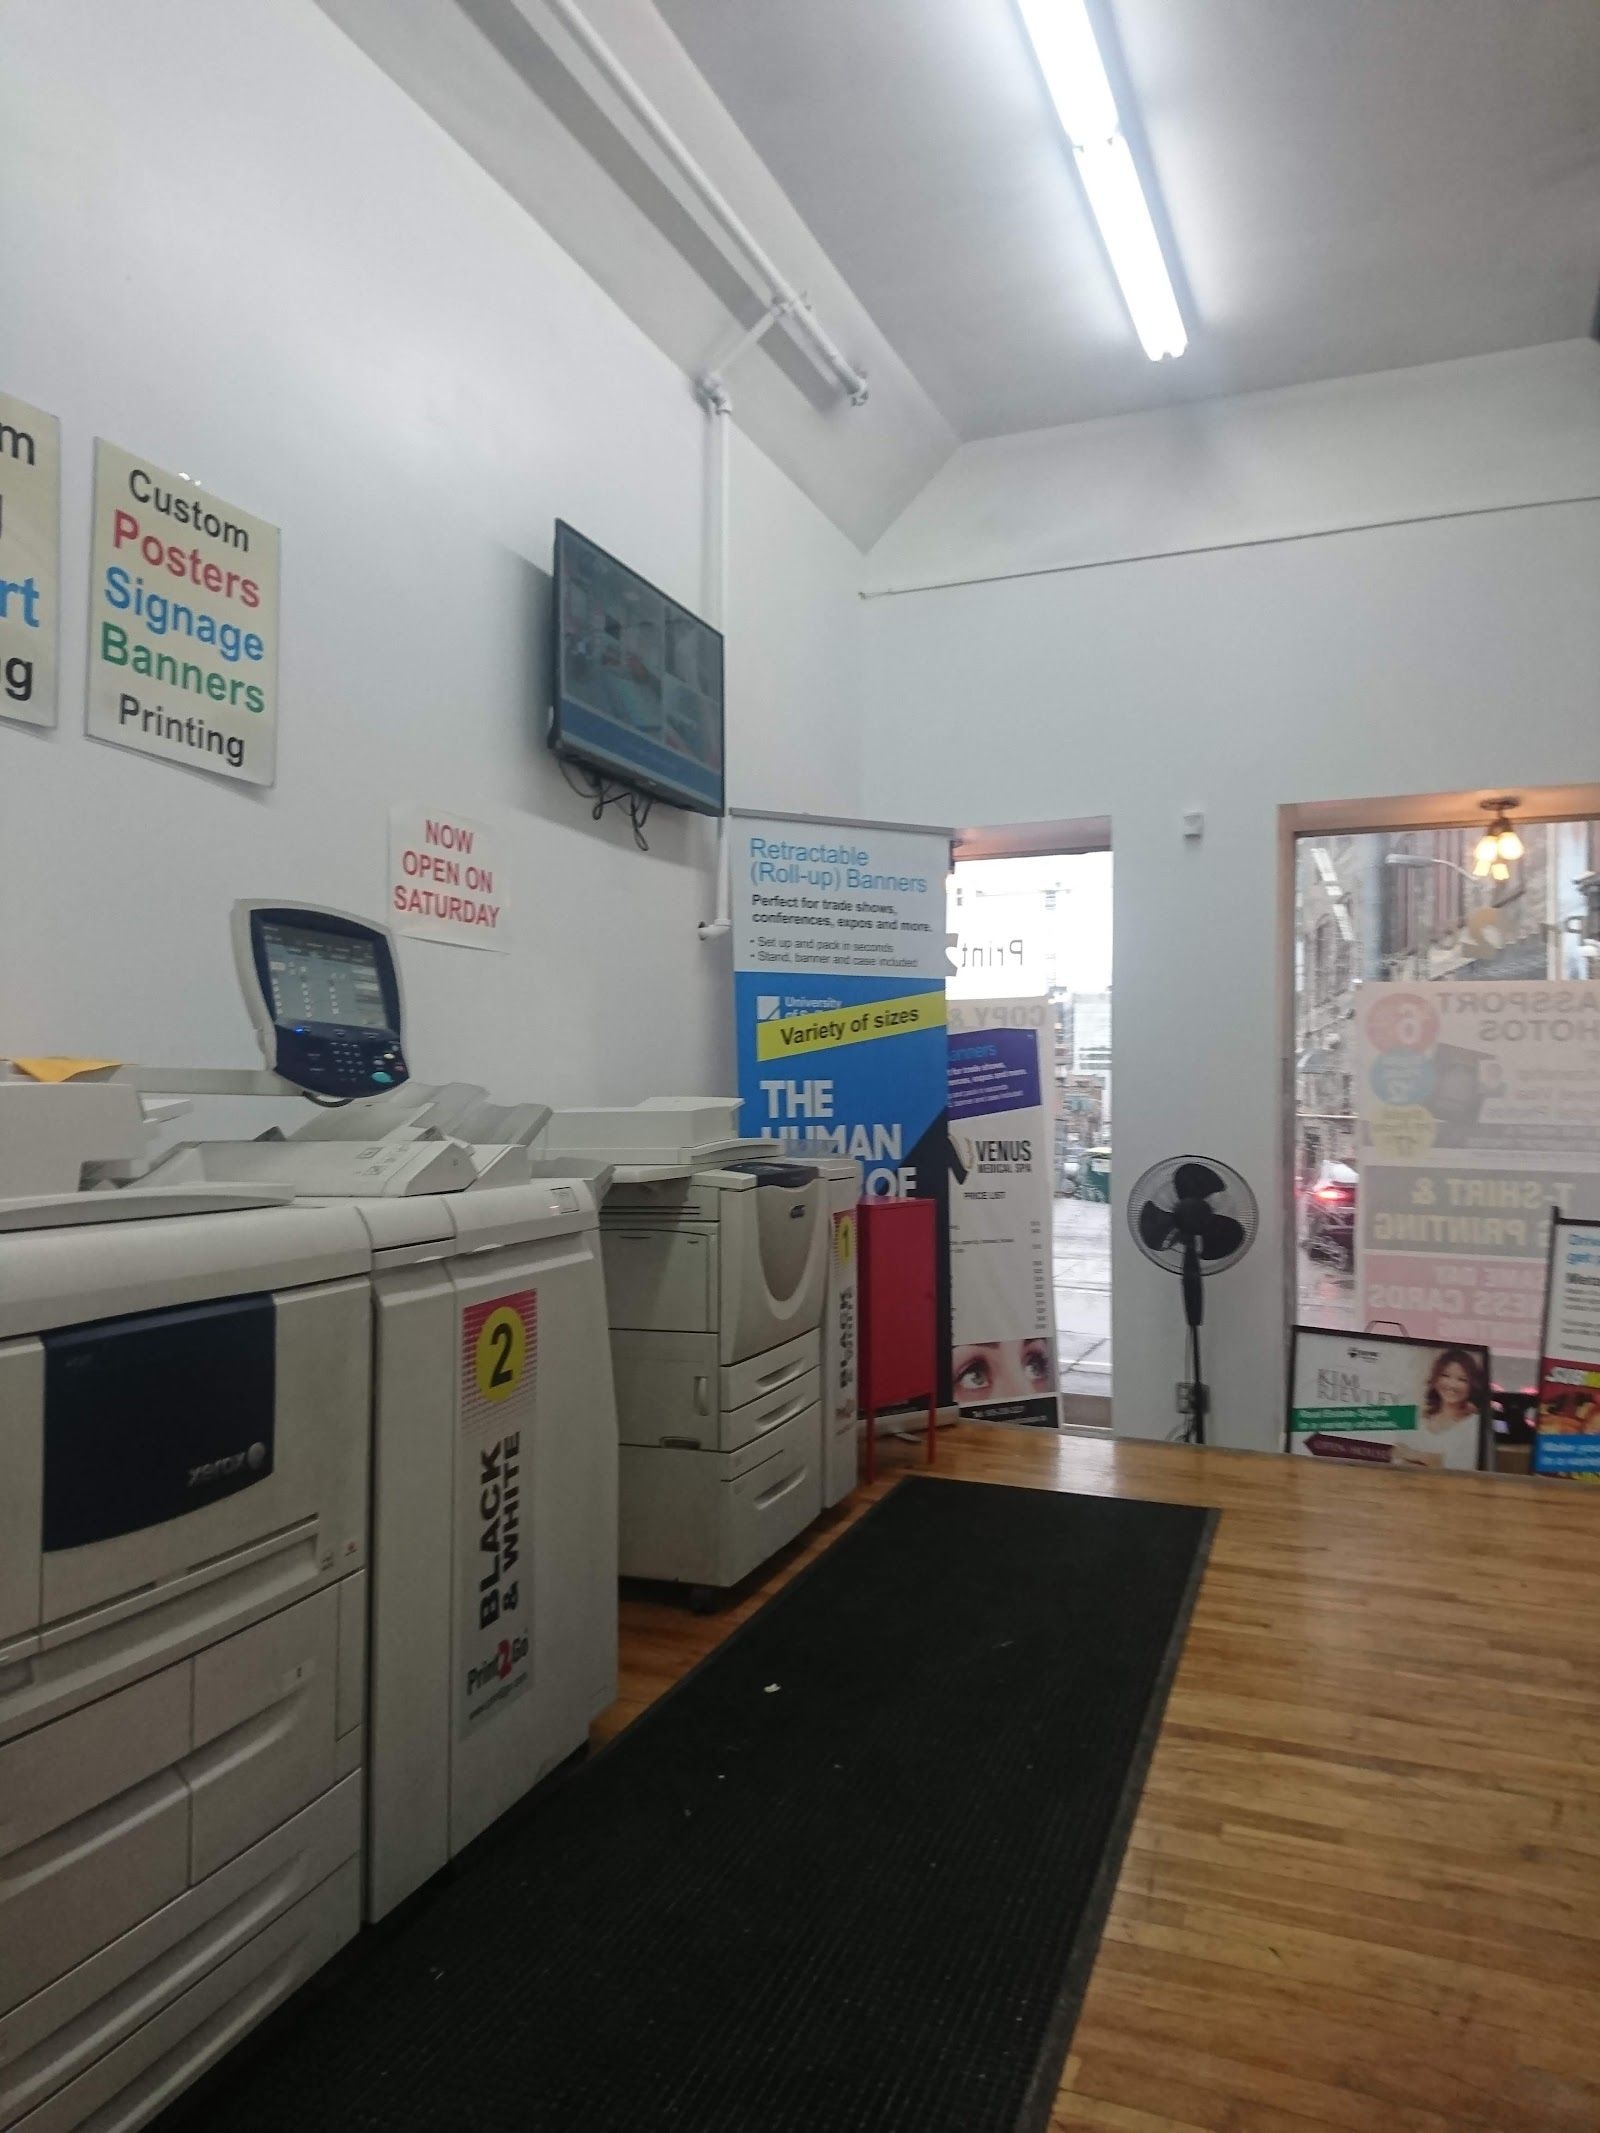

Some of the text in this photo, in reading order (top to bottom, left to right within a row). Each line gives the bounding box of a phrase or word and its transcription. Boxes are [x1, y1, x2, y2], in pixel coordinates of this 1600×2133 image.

[129, 470, 249, 552] Custom
[114, 508, 260, 608] Posters
[105, 566, 264, 662] Signage
[101, 621, 265, 714] Banners
[119, 693, 245, 767] Printing
[425, 819, 474, 854] NOW
[750, 837, 869, 866] Retractable
[402, 850, 493, 894] OPEN ON
[750, 861, 928, 893] (Roll-up) Banners
[393, 885, 500, 928] SATURDAY
[752, 894, 799, 908] Perfect
[801, 896, 820, 909] for
[822, 899, 854, 912] trade
[837, 918, 873, 931] expos
[876, 919, 898, 931] and
[784, 996, 842, 1010] University
[780, 1007, 919, 1046] Variety of sizes
[760, 1080, 833, 1118] THE
[975, 1139, 1032, 1162] VENUS
[866, 1167, 917, 1199] OF
[489, 1322, 513, 1388] 2
[480, 1440, 502, 1630] BLACK
[502, 1431, 521, 1611] & WHITE
